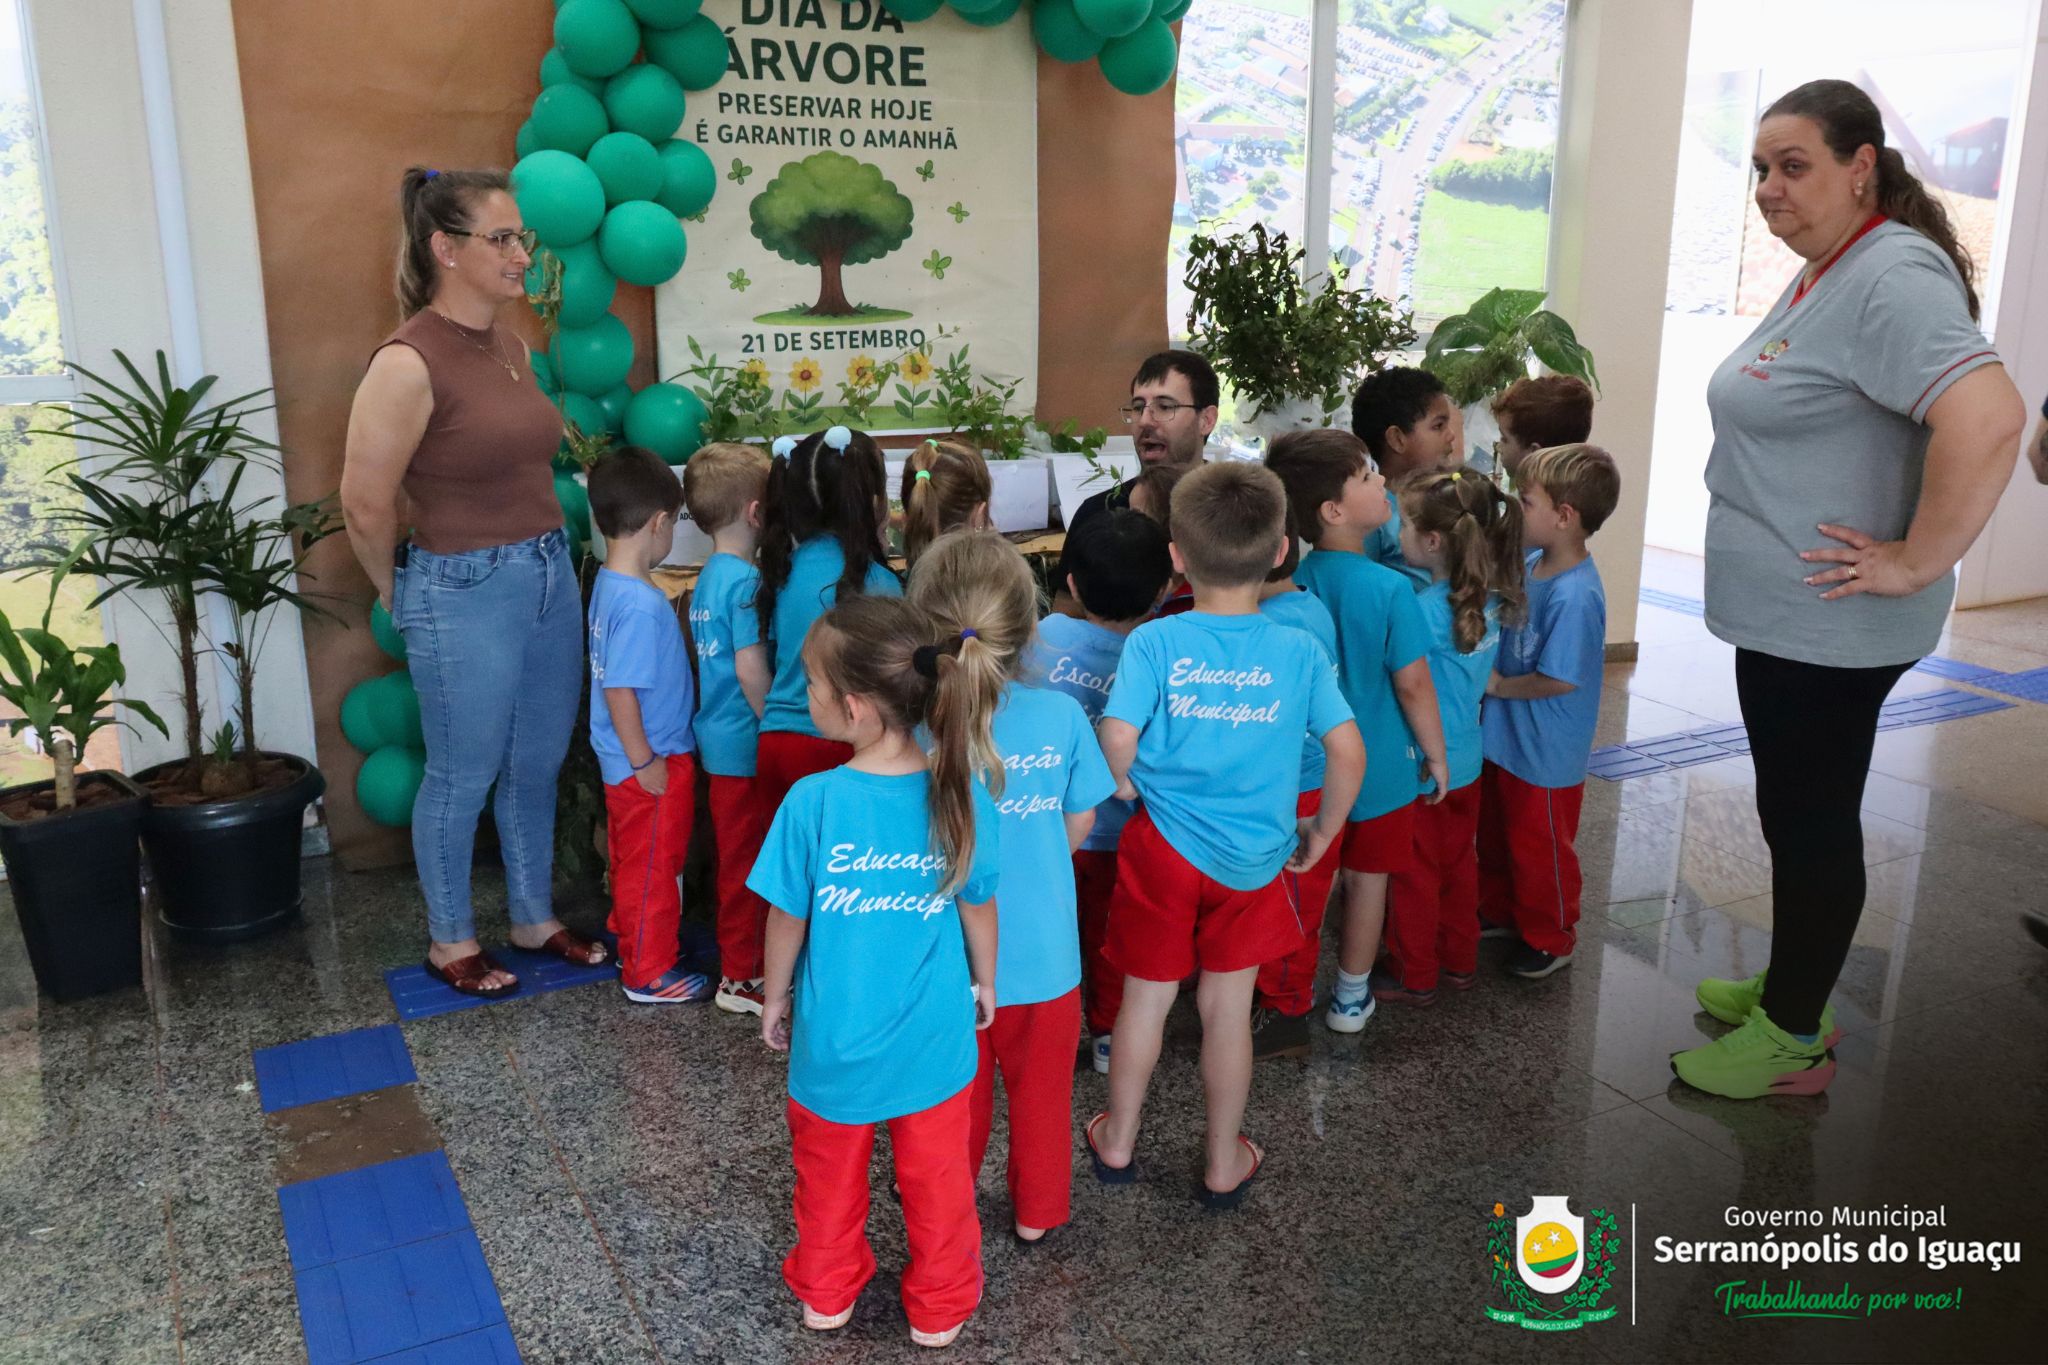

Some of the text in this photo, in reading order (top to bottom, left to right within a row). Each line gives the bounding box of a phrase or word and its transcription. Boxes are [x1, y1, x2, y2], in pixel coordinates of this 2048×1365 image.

[741, 0, 905, 34] DIA DA
[718, 92, 933, 122] PRESERVAR HOJE
[695, 119, 958, 150] É GARANTIR O AMANHÃ
[741, 328, 926, 354] 21 DE SETEMBRO
[1048, 656, 1116, 696] Escol
[1168, 657, 1275, 692] Educação
[1167, 693, 1281, 729] Municipal
[817, 884, 952, 921] Municip
